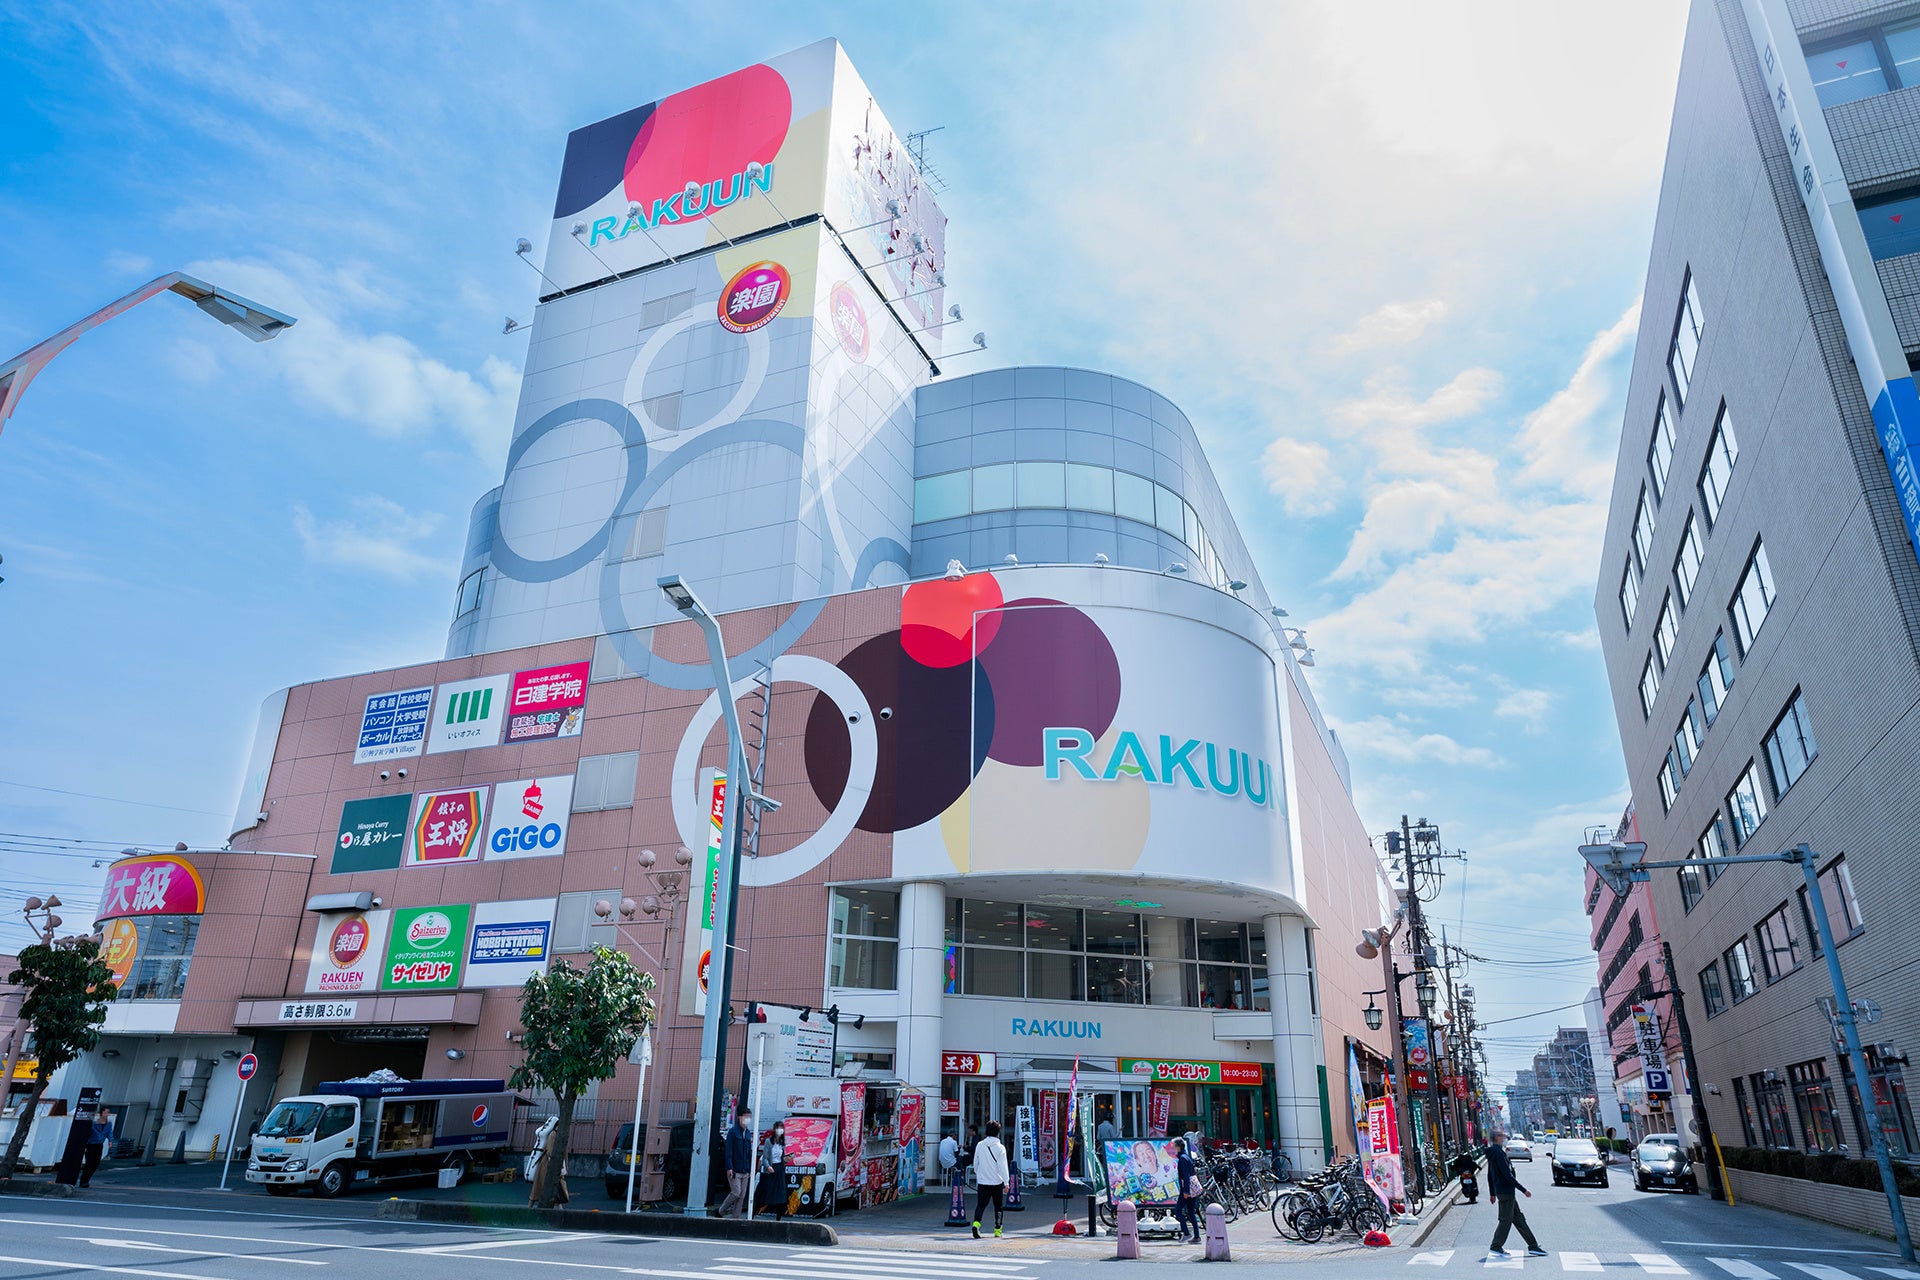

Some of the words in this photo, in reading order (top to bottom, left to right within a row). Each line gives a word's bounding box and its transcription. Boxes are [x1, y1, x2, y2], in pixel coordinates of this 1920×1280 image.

[1764, 42, 1814, 195] 日本生命
[589, 163, 773, 246] RAKUUN
[729, 280, 781, 315] 楽園
[719, 314, 744, 332] EXCITING
[745, 299, 786, 333] AMUSEMENT
[838, 301, 864, 347] 楽園
[515, 679, 582, 706] 日建学院
[369, 697, 396, 711] 英会話
[400, 692, 430, 706] 高校受験
[365, 715, 393, 727] パソコン
[396, 709, 427, 723] 大学受験
[512, 715, 536, 728] 建築士
[537, 711, 561, 724] 宅建士
[361, 731, 390, 745] ボーカル
[392, 732, 422, 743] デイサービス
[448, 728, 481, 740] いいオフィス
[510, 722, 557, 739] 施工管理技士
[1043, 727, 1286, 818] RAKUUN
[437, 801, 465, 816] 餃子の
[525, 803, 542, 815] GAME
[357, 822, 375, 832] Hinoya
[375, 820, 389, 830] Curry
[425, 817, 468, 849] 王将
[491, 822, 562, 854] GiGO
[410, 923, 447, 941] Saizeriya
[335, 933, 365, 952] 楽園
[476, 934, 544, 949] HOBBYSTATION
[475, 947, 528, 958] ホビーステーション
[320, 971, 364, 984] RAKUEN
[392, 961, 452, 983] サイゼリヤ
[318, 983, 344, 991] PACHINKO
[349, 982, 362, 990] SLOT
[283, 1003, 352, 1019] 高さ制限3.6M
[1012, 1018, 1102, 1039] RAKUUN
[1640, 1021, 1662, 1070] 駐車場
[945, 1056, 975, 1071] 王将
[1158, 1063, 1211, 1080] サイゼリヤ
[1223, 1069, 1259, 1078] 10:00-23:00
[1650, 1074, 1662, 1088] P
[1020, 1107, 1033, 1160] 接種会場
[799, 1166, 807, 1174] HOT
[807, 1166, 816, 1174] DOG
